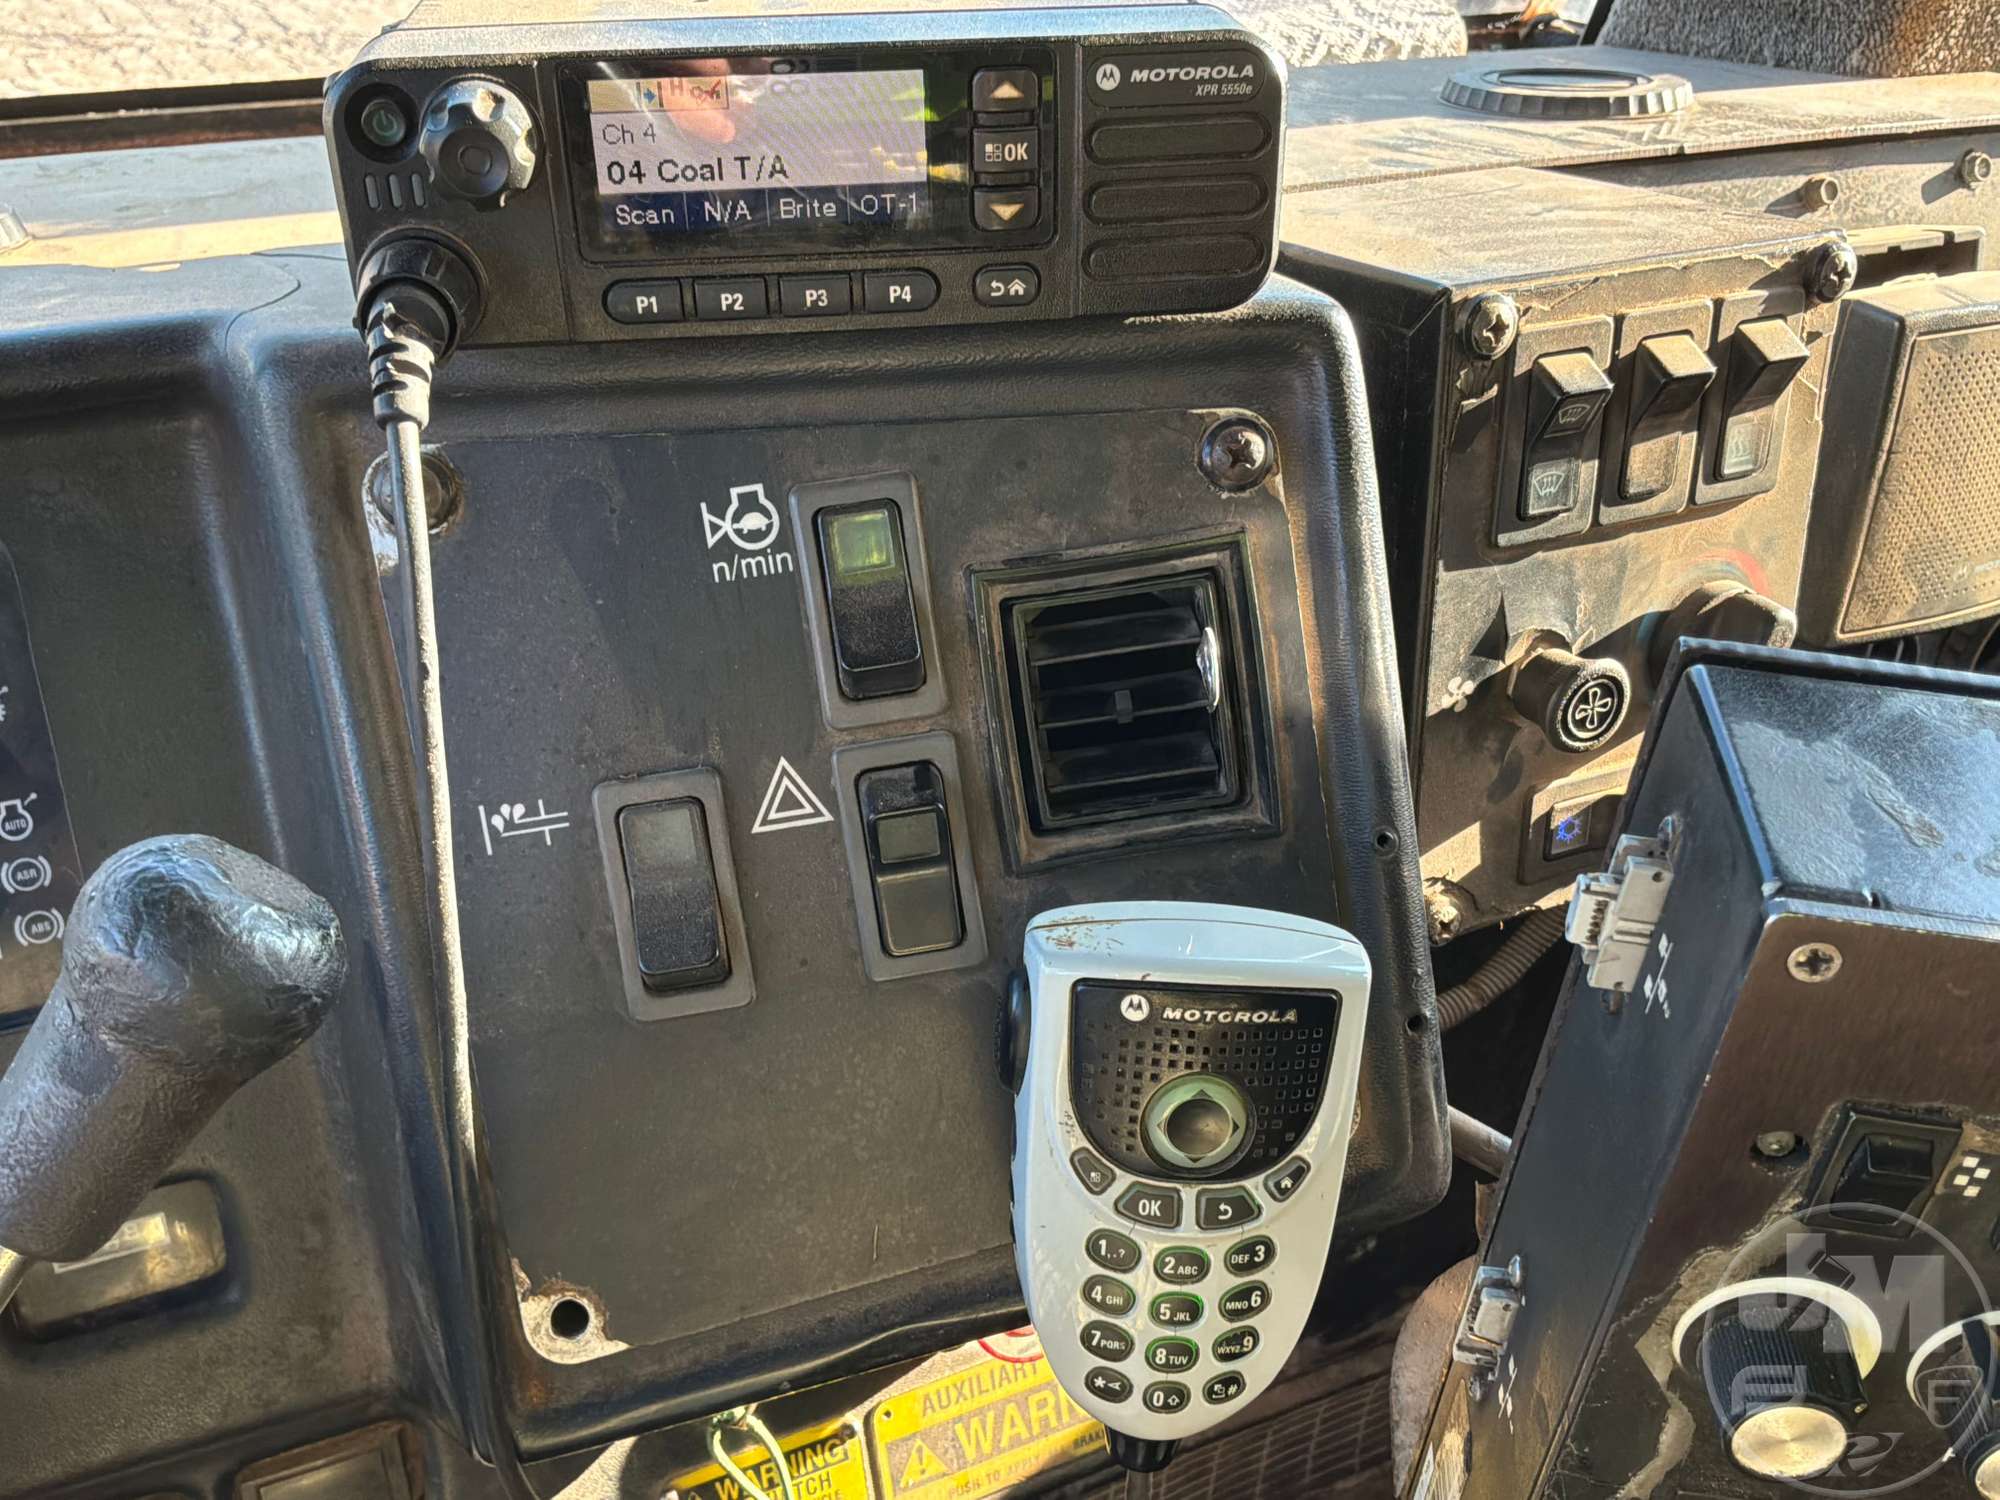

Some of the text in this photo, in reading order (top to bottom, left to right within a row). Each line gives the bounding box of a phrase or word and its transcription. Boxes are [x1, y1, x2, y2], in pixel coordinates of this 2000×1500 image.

[1129, 64, 1255, 84] MOTOROLA
[1195, 82, 1253, 97] XPR 5550e
[602, 123, 657, 145] Ch 4
[1004, 142, 1029, 162] OK
[606, 154, 790, 185] 04 Coal T/A
[704, 200, 752, 223] N/A
[779, 198, 838, 220] Brite
[860, 193, 918, 216] OT-1
[615, 205, 675, 226] Scan
[720, 293, 745, 312] P2
[805, 289, 829, 308] P3
[889, 286, 913, 304] P4
[635, 295, 659, 315] P1
[711, 548, 794, 583] n/min
[4, 818, 28, 832] AUTO
[16, 870, 38, 882] ASR
[1162, 1007, 1298, 1024] MOTOROLA
[1138, 1199, 1162, 1217] OK
[1163, 1257, 1199, 1276] 2 ABC
[1090, 1286, 1103, 1303] 4
[1250, 1291, 1262, 1309] 6
[1159, 1304, 1192, 1322] 5 JKL
[1155, 1348, 1189, 1366] 8 TUV
[1152, 1391, 1164, 1407] 0
[985, 1469, 1001, 1485] TO
